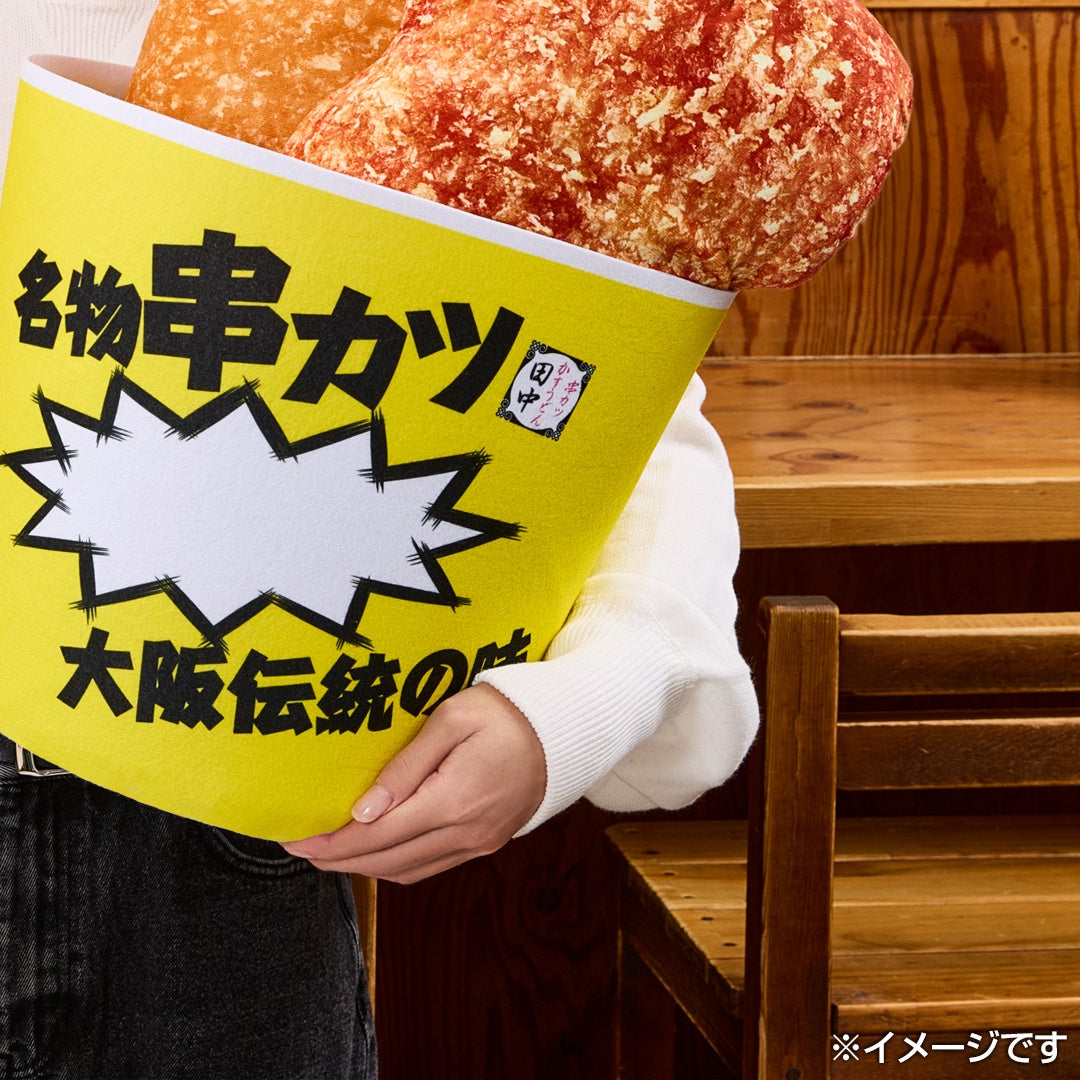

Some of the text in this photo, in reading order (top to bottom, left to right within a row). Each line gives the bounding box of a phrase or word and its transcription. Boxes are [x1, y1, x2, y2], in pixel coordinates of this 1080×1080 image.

[14, 229, 525, 412] 名物串カツ
[517, 362, 554, 413] 田中
[530, 362, 570, 427] かすうどん
[554, 380, 580, 417] 串カツ
